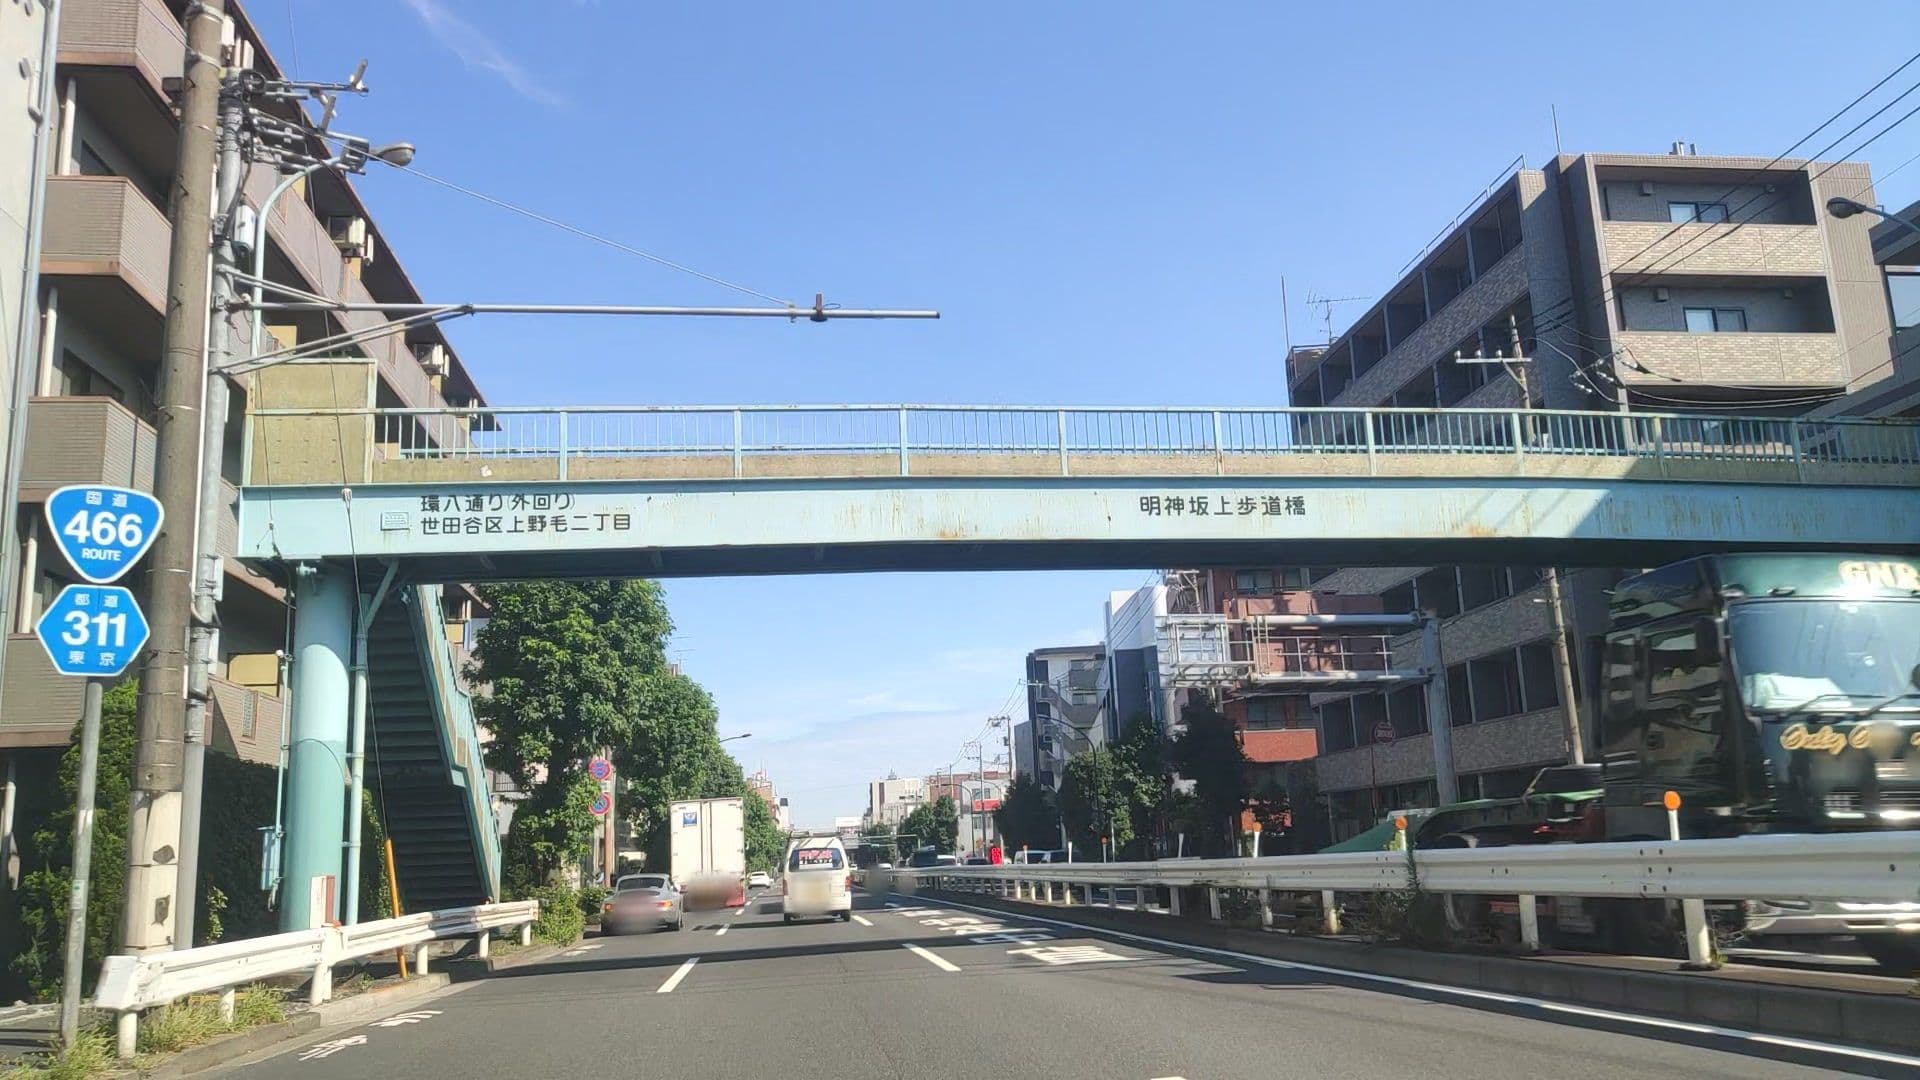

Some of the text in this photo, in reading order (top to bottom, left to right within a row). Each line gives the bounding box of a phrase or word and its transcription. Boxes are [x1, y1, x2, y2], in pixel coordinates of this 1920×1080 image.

[85, 490, 128, 508] 国道
[420, 492, 575, 512] 環八通り(外回り)
[1139, 495, 1306, 516] 明神坂上歩道橋
[63, 509, 143, 548] 466
[420, 513, 631, 536] 世田谷区上野毛二丁目
[81, 547, 122, 561] ROUTE
[75, 593, 119, 608] 都道
[61, 609, 127, 648] 311
[68, 650, 116, 667] 東京
